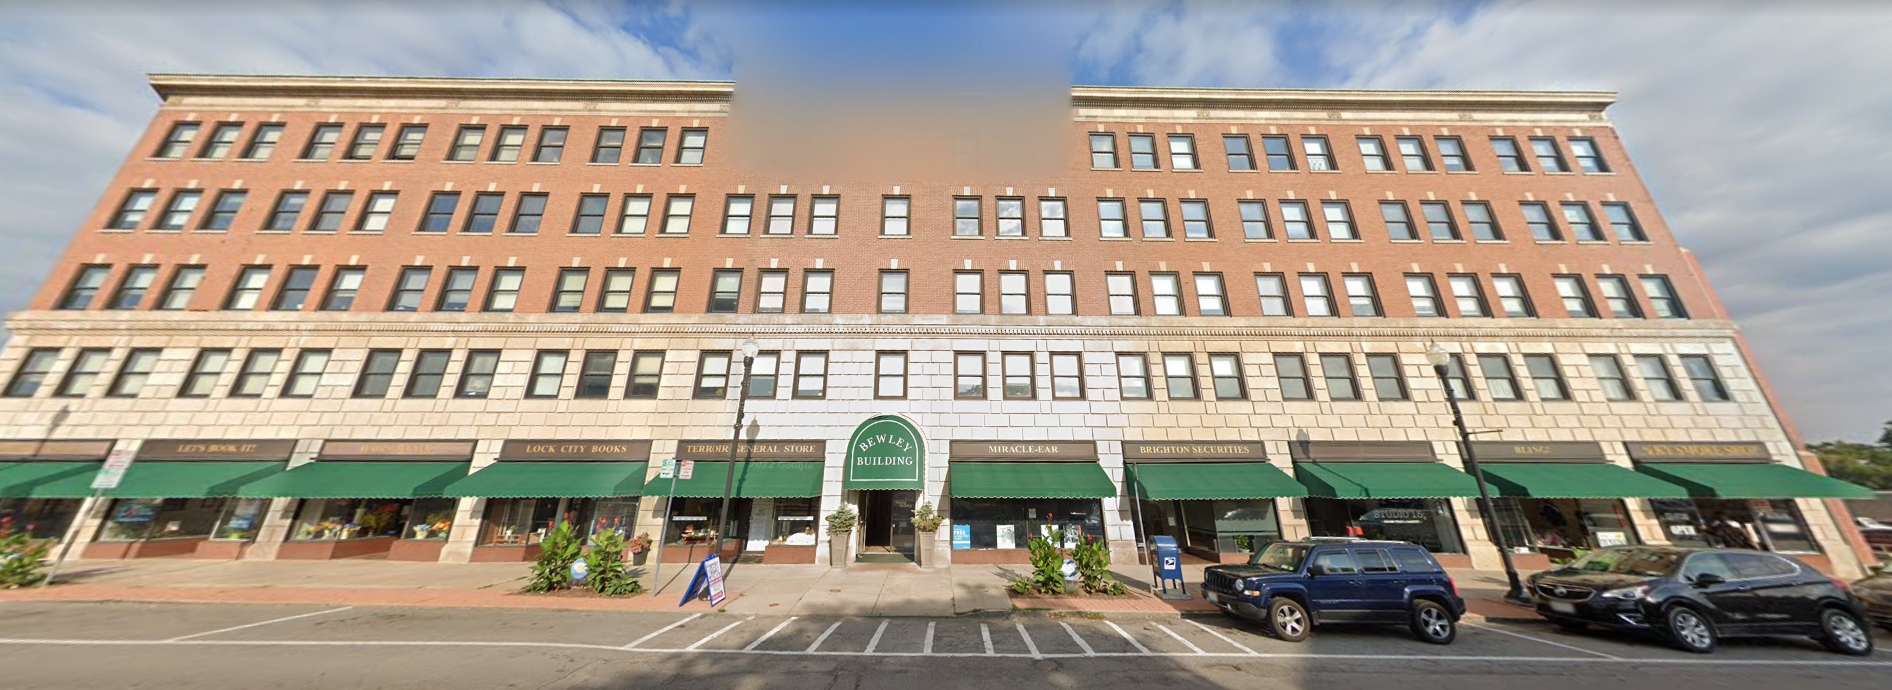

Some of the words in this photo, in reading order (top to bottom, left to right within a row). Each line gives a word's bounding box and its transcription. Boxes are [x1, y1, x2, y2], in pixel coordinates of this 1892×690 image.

[859, 433, 913, 453] BEWLEY
[206, 444, 238, 453] BOOK
[525, 445, 556, 453] LOCK
[560, 445, 587, 453] CITY
[591, 445, 628, 453] BOOKS
[686, 445, 729, 453] TERROIR
[736, 445, 780, 453] GENERAL
[783, 445, 816, 453] STORE
[988, 445, 1059, 453] MIRACLE-EAR
[1139, 445, 1190, 454] BRIGHTON
[1192, 445, 1250, 454] SECURITIES
[856, 456, 914, 466] BUILDING
[1374, 509, 1409, 519] STUDIO
